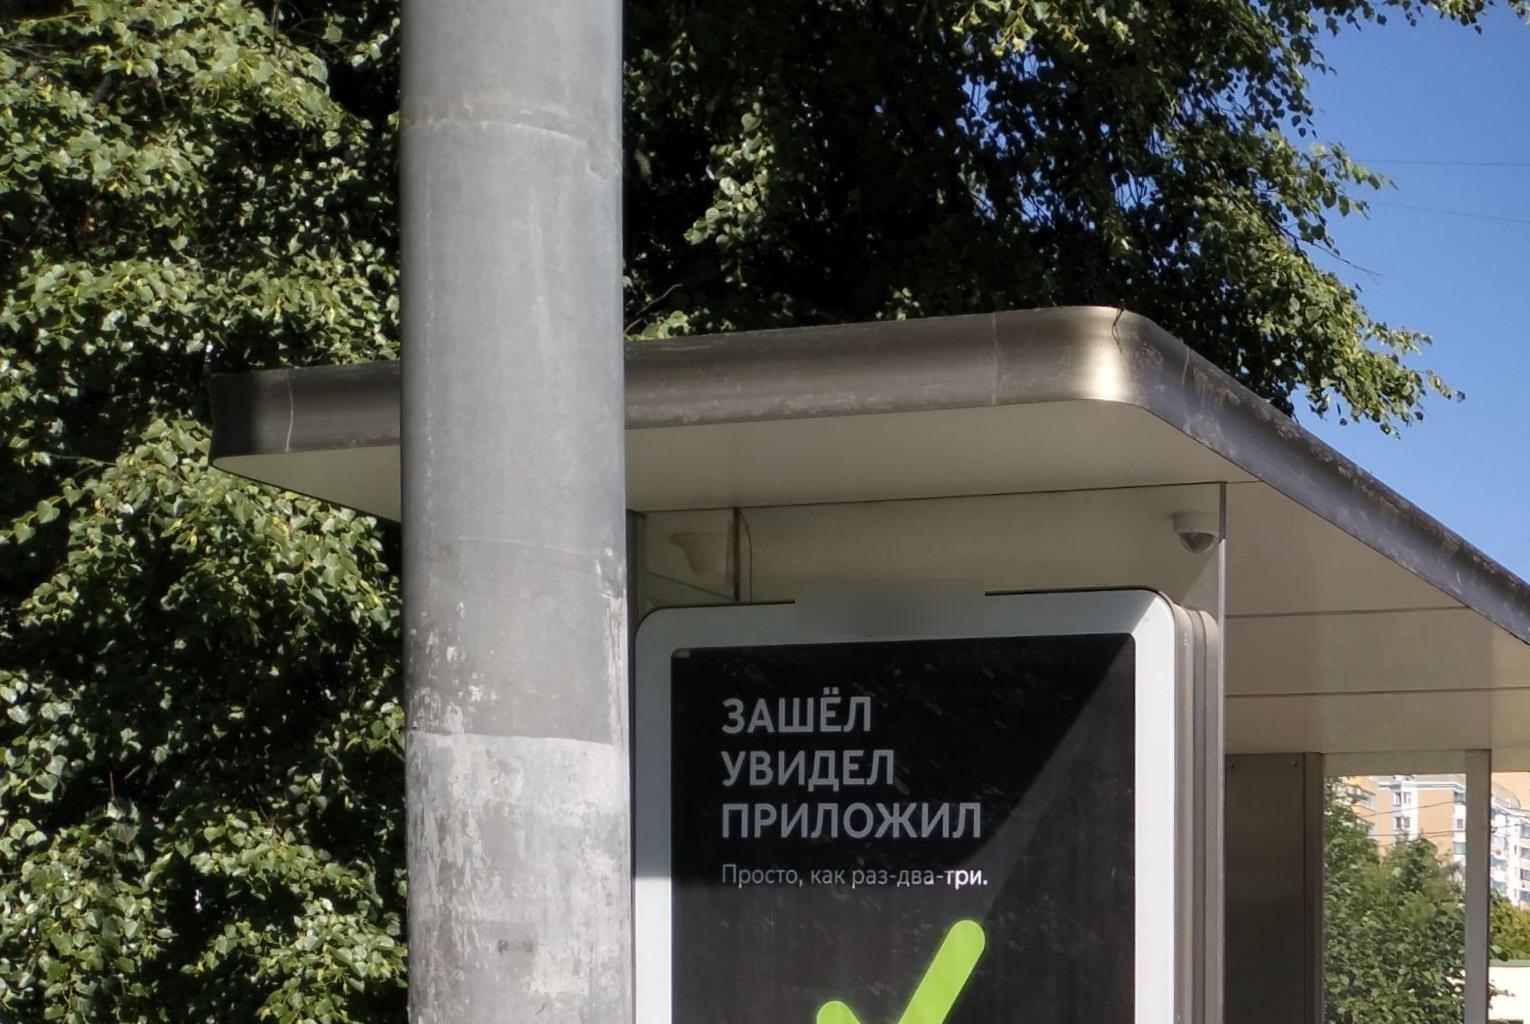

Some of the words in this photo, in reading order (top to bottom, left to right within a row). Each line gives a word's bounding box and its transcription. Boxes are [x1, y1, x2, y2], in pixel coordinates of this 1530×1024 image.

[721, 686, 872, 734] ЗАШЁЛ
[721, 750, 895, 792] УВИДЕЛ
[721, 802, 982, 839] ПРИЛОЖИЛ
[721, 864, 804, 888] Просто,
[810, 869, 846, 886] как
[852, 868, 988, 889] раз-два-три.
